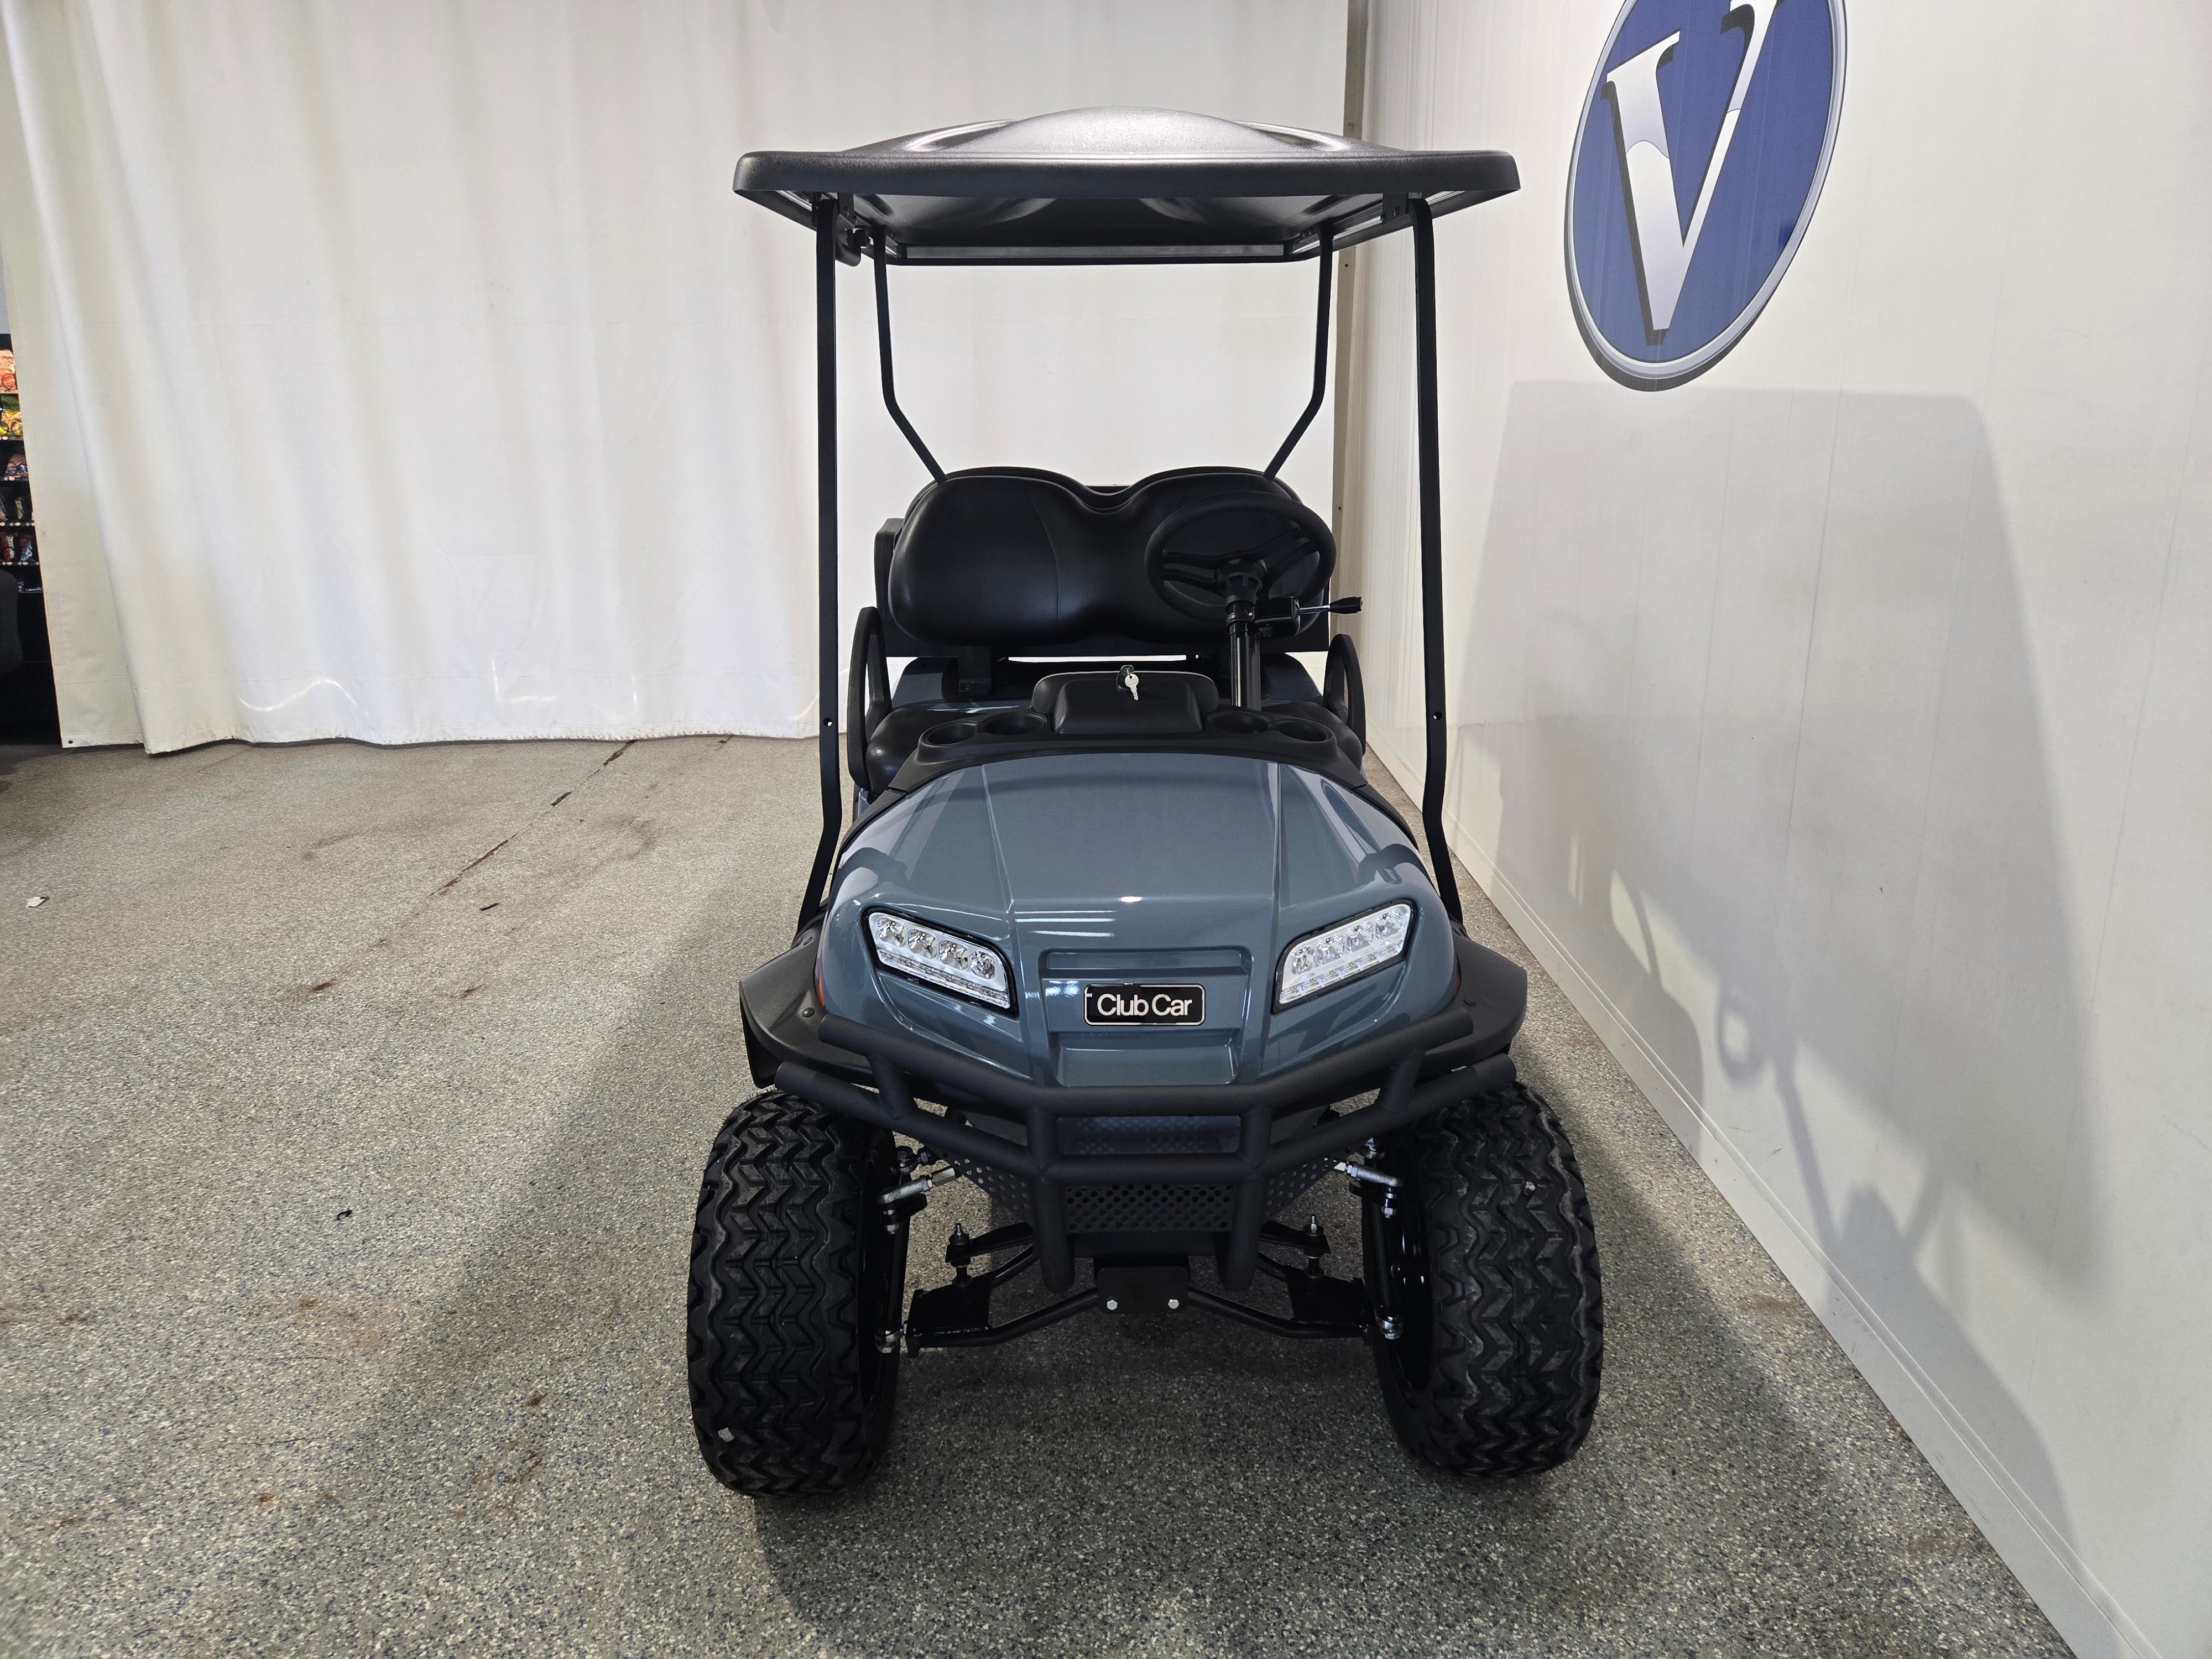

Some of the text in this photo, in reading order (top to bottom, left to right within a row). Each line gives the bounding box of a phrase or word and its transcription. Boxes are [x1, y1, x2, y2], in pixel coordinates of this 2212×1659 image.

[1605, 0, 1777, 332] V
[1097, 993, 1192, 1016] Club Car
